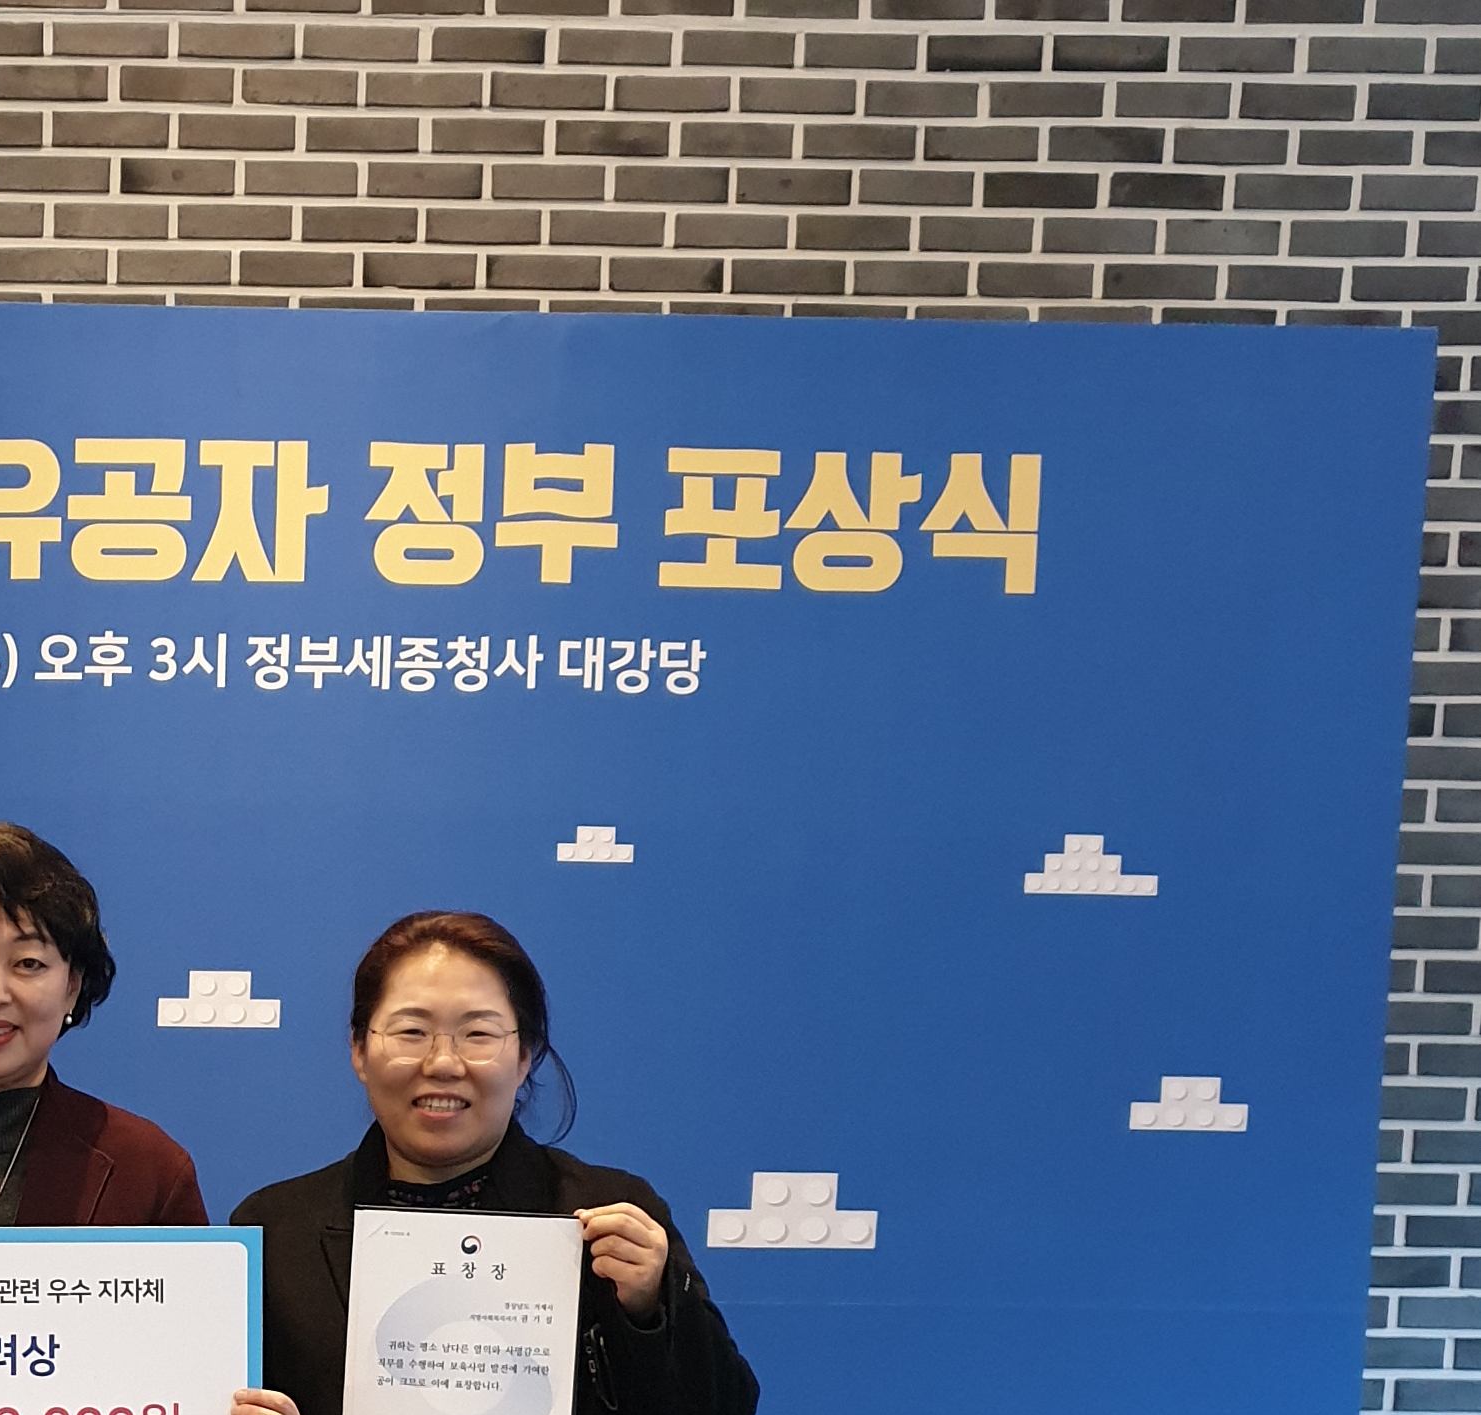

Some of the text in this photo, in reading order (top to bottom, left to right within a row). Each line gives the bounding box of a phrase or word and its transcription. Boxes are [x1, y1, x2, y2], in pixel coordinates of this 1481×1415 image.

[366, 443, 619, 586] 정부
[660, 449, 1042, 595] 포상식
[35, 632, 134, 688] 오후
[149, 635, 228, 689] 3시
[246, 635, 545, 694] 정부세종청사
[559, 639, 708, 696] 대강당
[430, 1262, 507, 1281] 표 창 장
[48, 1279, 93, 1305] 우수
[99, 1279, 165, 1305] 지자체
[388, 1341, 415, 1351] 귀하는
[419, 1342, 438, 1351] 평소
[442, 1343, 469, 1354] 남다른
[505, 1345, 551, 1357] 사명감으로
[377, 1358, 550, 1376] 직무를 수행하여 보육사업 발전에 기여한
[376, 1375, 394, 1386] 공이
[431, 1378, 450, 1389] 이에
[455, 1380, 503, 1391] 표창합니다.
